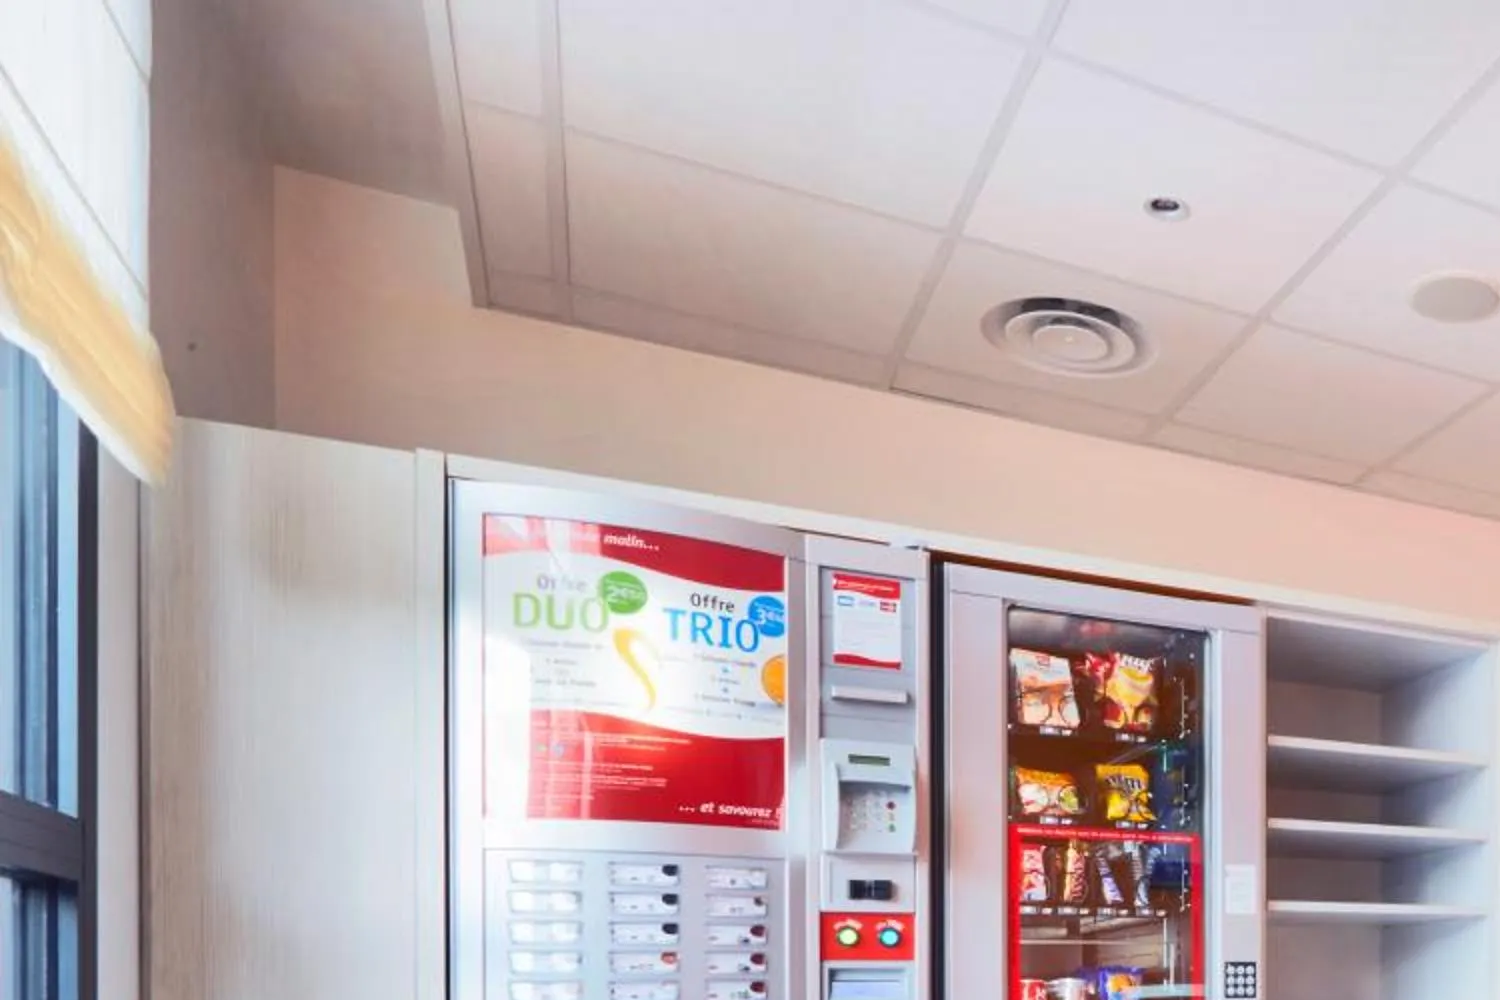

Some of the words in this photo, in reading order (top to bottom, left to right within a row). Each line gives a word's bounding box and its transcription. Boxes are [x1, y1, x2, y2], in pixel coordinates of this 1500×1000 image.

[511, 591, 610, 634] DUO
[689, 591, 736, 614] Offre
[661, 606, 761, 654] TRIO
[699, 800, 716, 815] et
[718, 802, 774, 820] savourez
